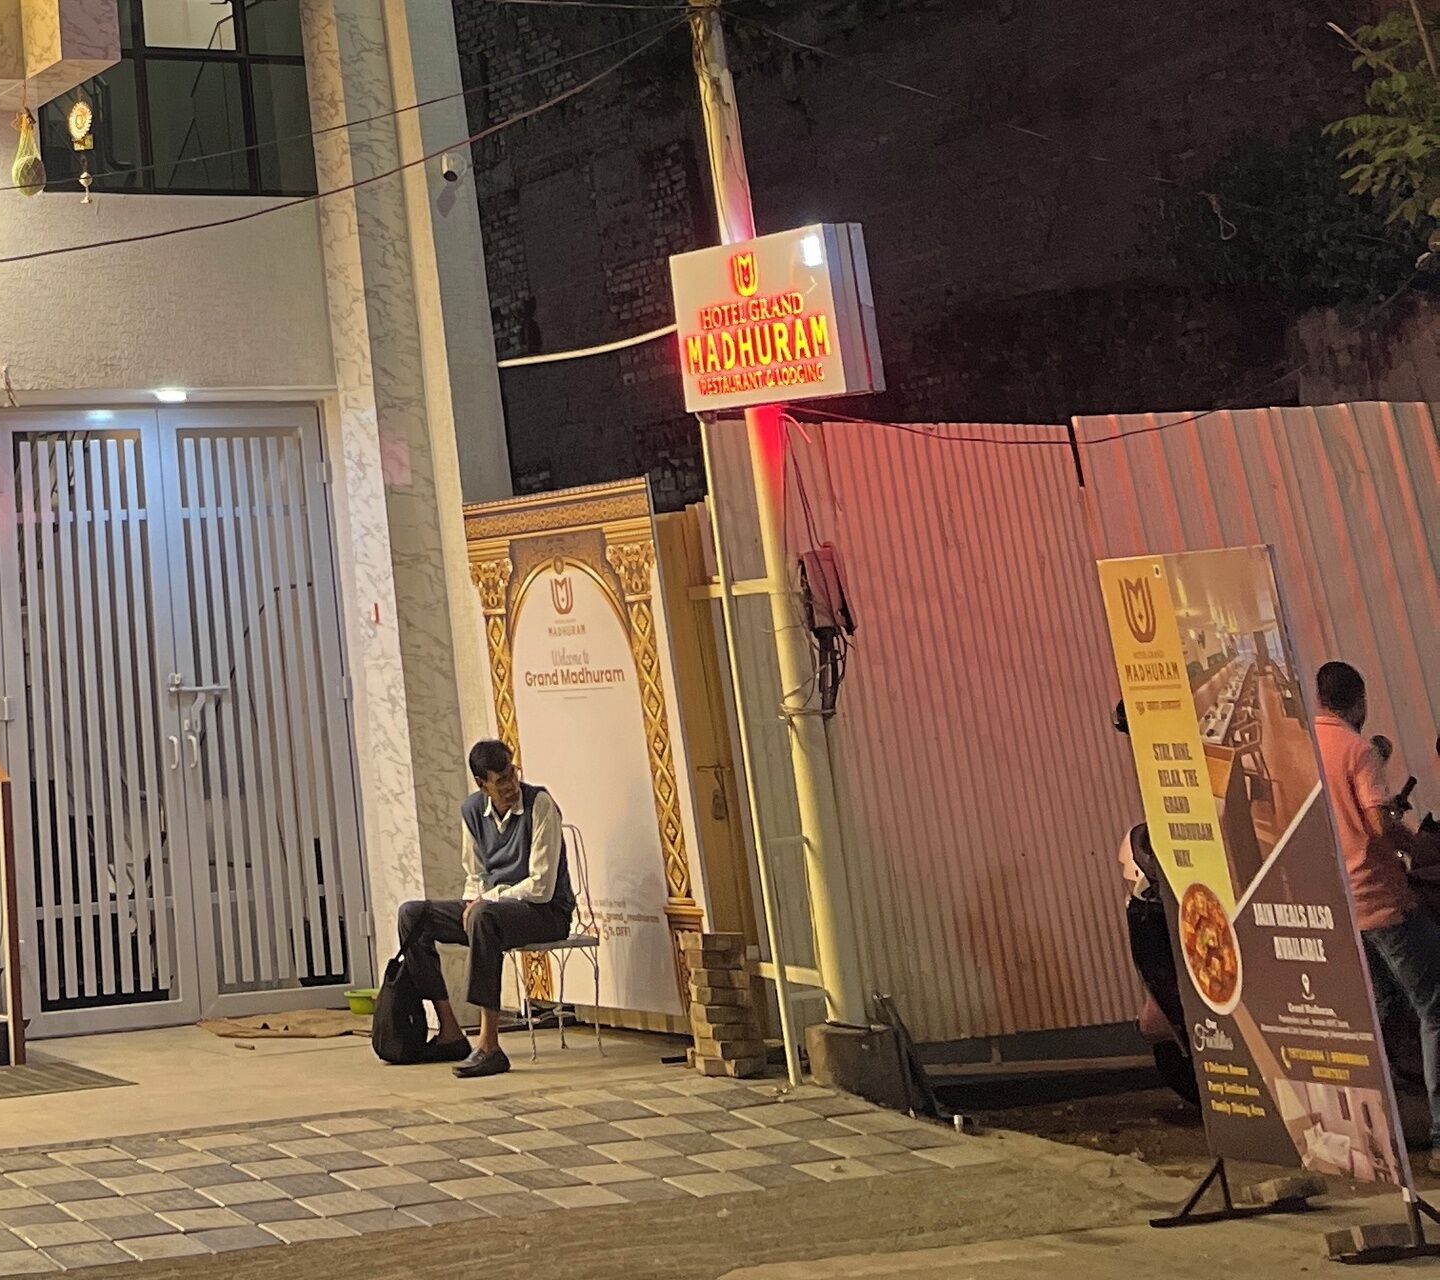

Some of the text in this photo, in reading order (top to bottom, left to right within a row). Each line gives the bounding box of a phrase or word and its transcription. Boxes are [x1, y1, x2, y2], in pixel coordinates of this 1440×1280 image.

[701, 292, 804, 329] HOTEL GRAND
[687, 314, 831, 376] MADHURAM
[776, 363, 826, 387] LODGING
[525, 667, 625, 687] Grand Madhuram
[1125, 661, 1181, 683] MADHURAM
[1274, 903, 1308, 929] MEALS
[1307, 905, 1334, 930] ALSO
